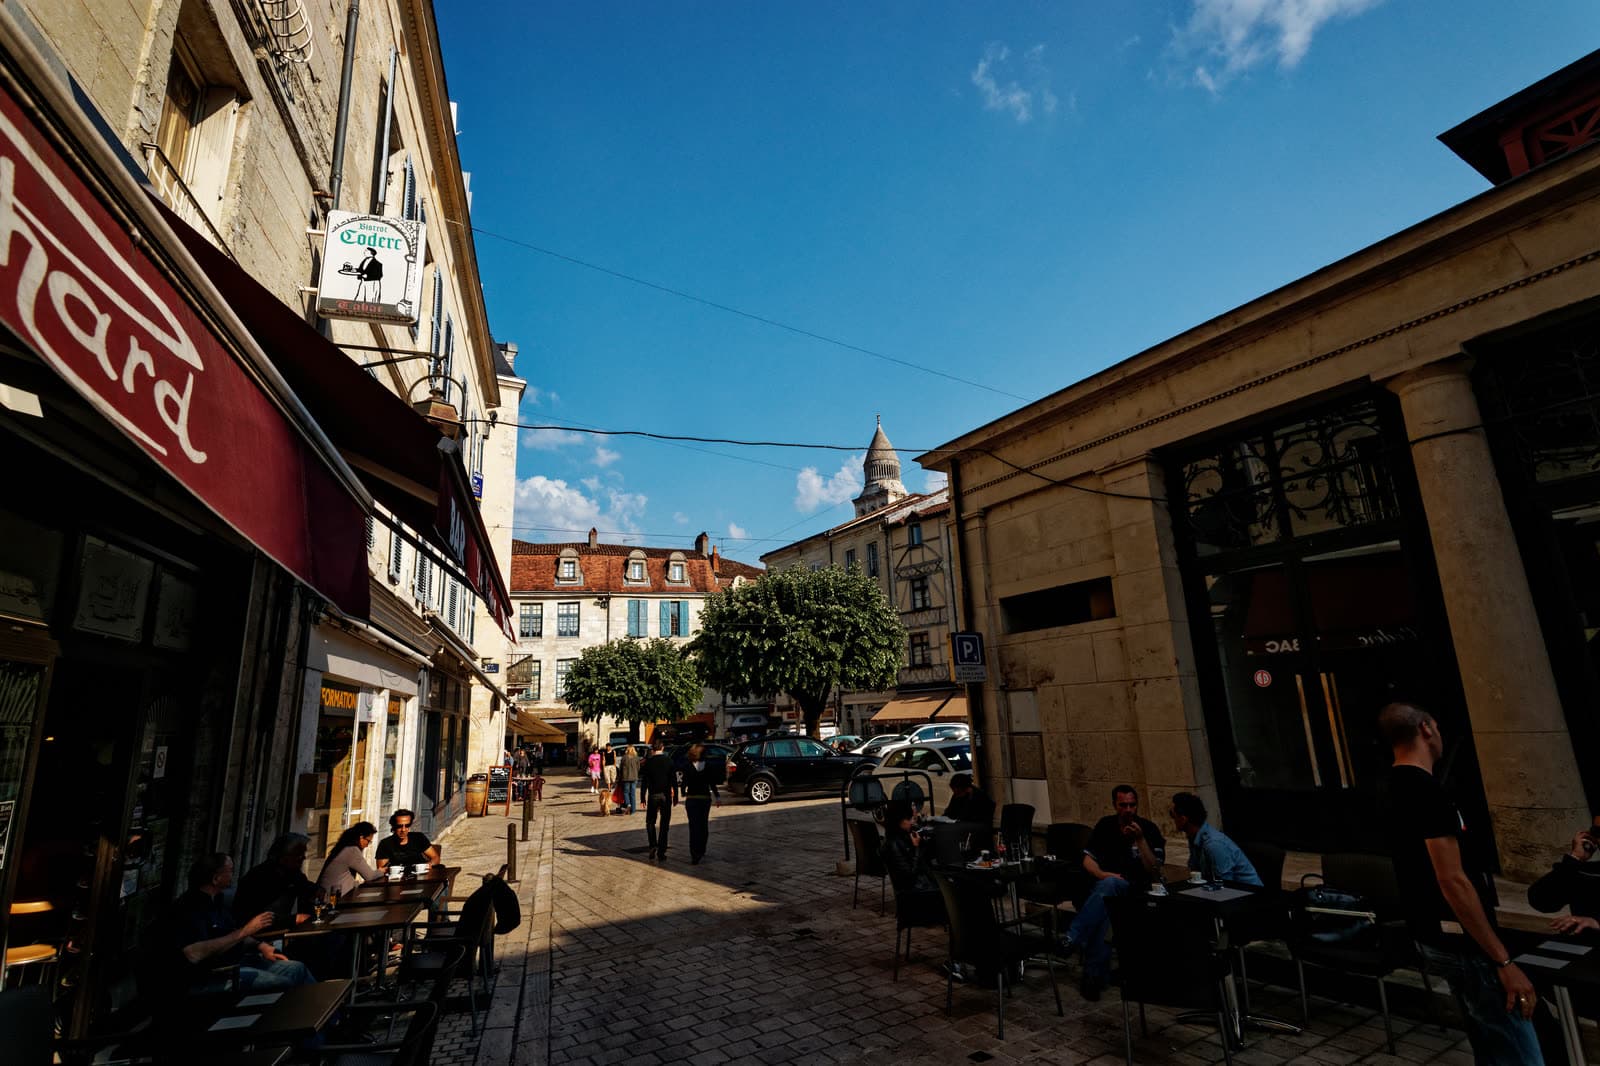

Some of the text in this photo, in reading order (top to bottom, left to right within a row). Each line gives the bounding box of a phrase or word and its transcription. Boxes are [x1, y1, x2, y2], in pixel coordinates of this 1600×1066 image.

[359, 223, 388, 232] Bistrot
[340, 229, 403, 250] Coderc
[336, 299, 383, 313] Tabac
[449, 496, 466, 567] BAR
[962, 641, 974, 658] P
